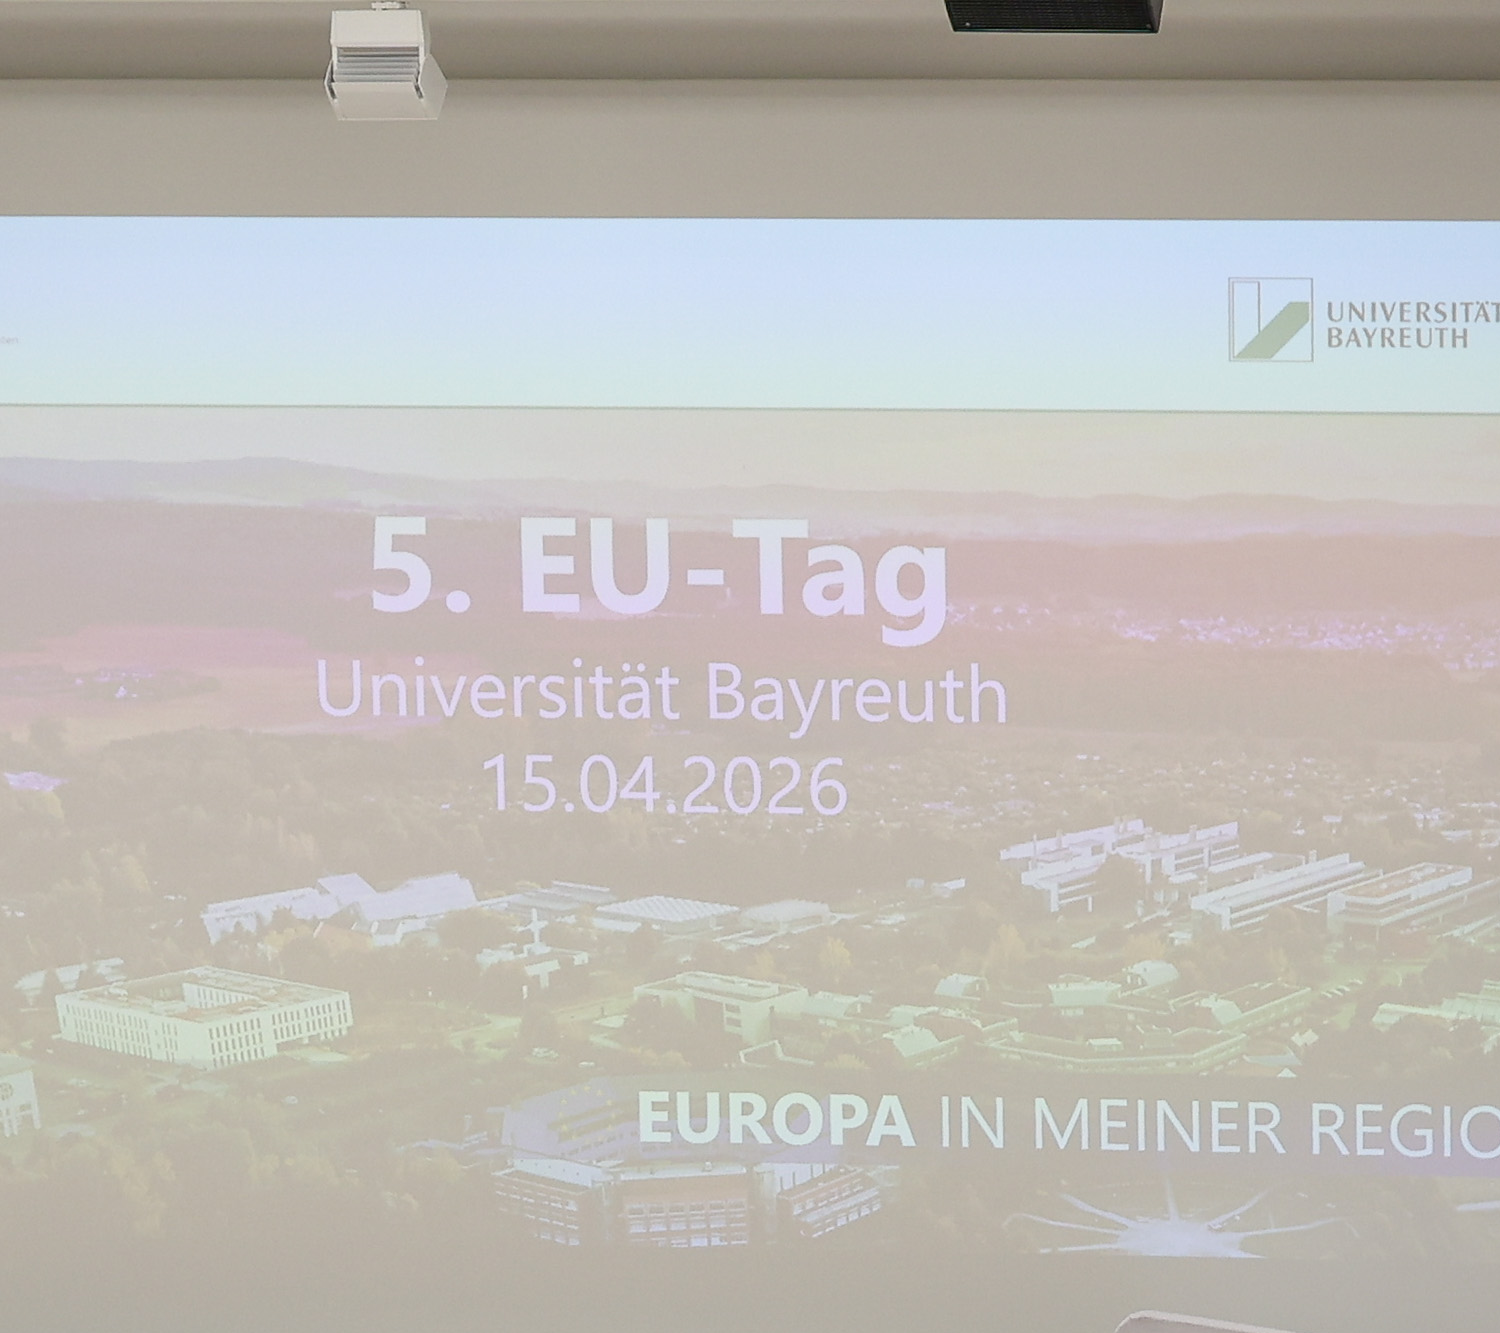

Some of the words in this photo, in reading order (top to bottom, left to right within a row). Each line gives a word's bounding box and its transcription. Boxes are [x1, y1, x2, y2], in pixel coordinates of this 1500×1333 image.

[1327, 326, 1469, 349] BAYREUTH
[370, 515, 472, 614] 5.
[519, 516, 948, 648] EU-Tag
[316, 655, 680, 721] Universität
[706, 661, 1008, 740] Bayreuth
[482, 752, 849, 816] 15.04.2026
[636, 1089, 916, 1148] EUROPA
[941, 1095, 1005, 1151] IN
[1032, 1096, 1286, 1156] MEINER
